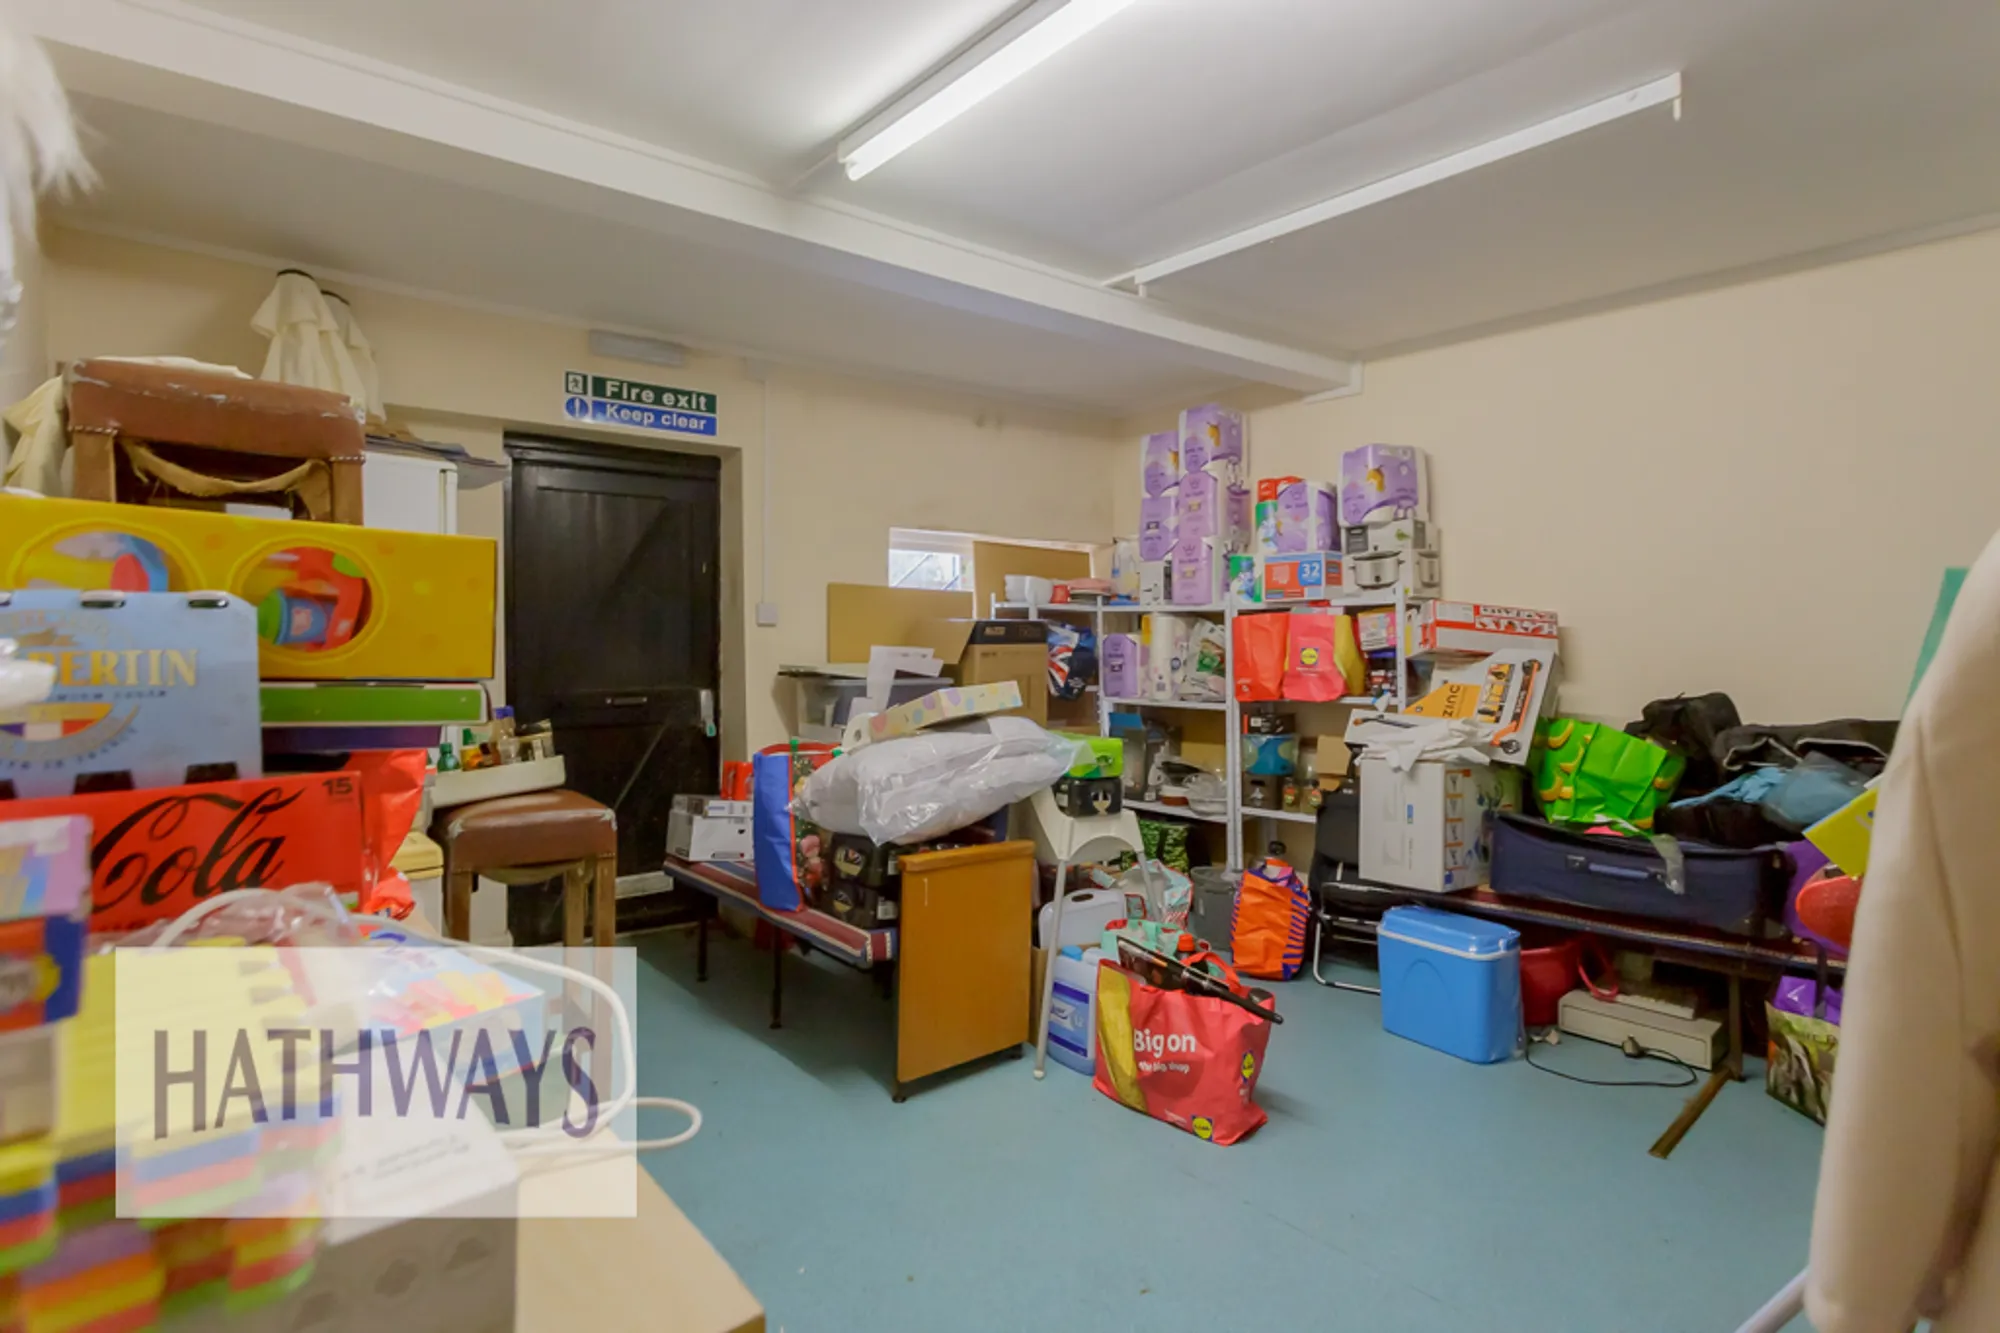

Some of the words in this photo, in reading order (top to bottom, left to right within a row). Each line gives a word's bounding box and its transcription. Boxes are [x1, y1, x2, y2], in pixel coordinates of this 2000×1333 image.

[605, 380, 654, 402] Fire
[662, 391, 707, 410] exit
[606, 404, 655, 426] Keep
[661, 413, 706, 430] clear
[1301, 562, 1321, 579] 32
[322, 776, 354, 796] 15
[91, 786, 306, 914] Cola
[1134, 1028, 1164, 1058] Big
[1167, 1034, 1196, 1053] on
